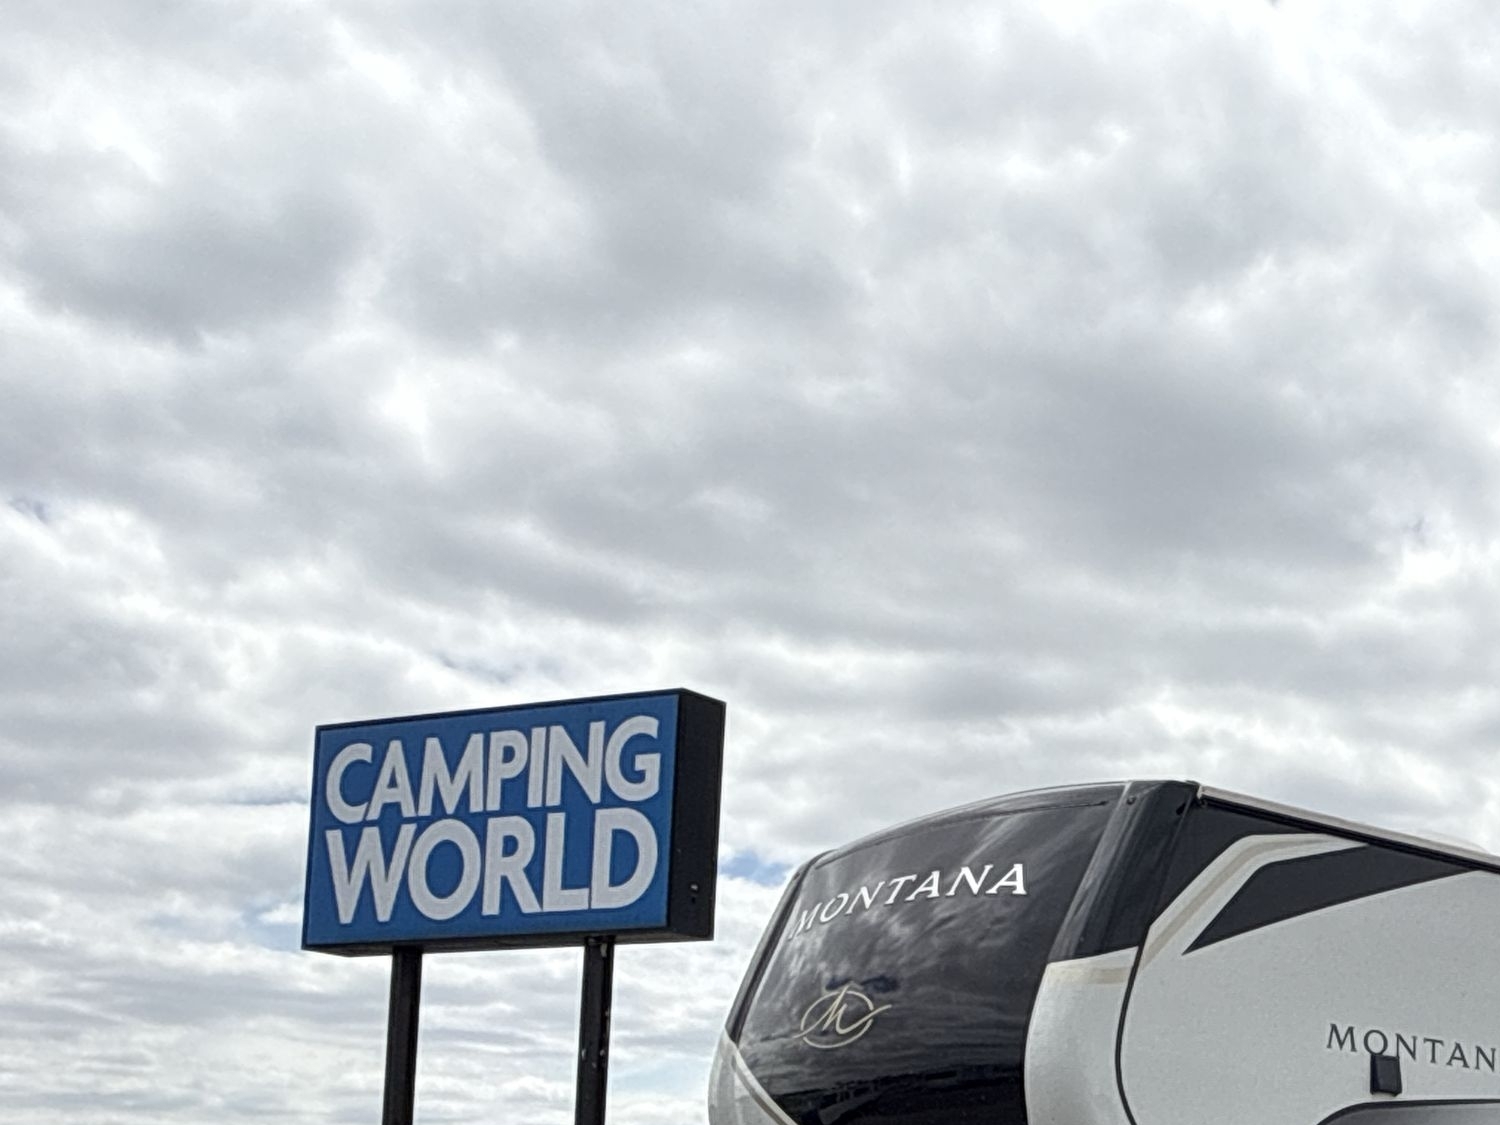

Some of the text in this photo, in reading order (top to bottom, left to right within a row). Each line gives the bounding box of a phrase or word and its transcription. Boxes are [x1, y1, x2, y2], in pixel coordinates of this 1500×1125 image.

[325, 714, 662, 824] CAMPING
[325, 807, 659, 925] WORLD
[787, 863, 1028, 941] MONTANA
